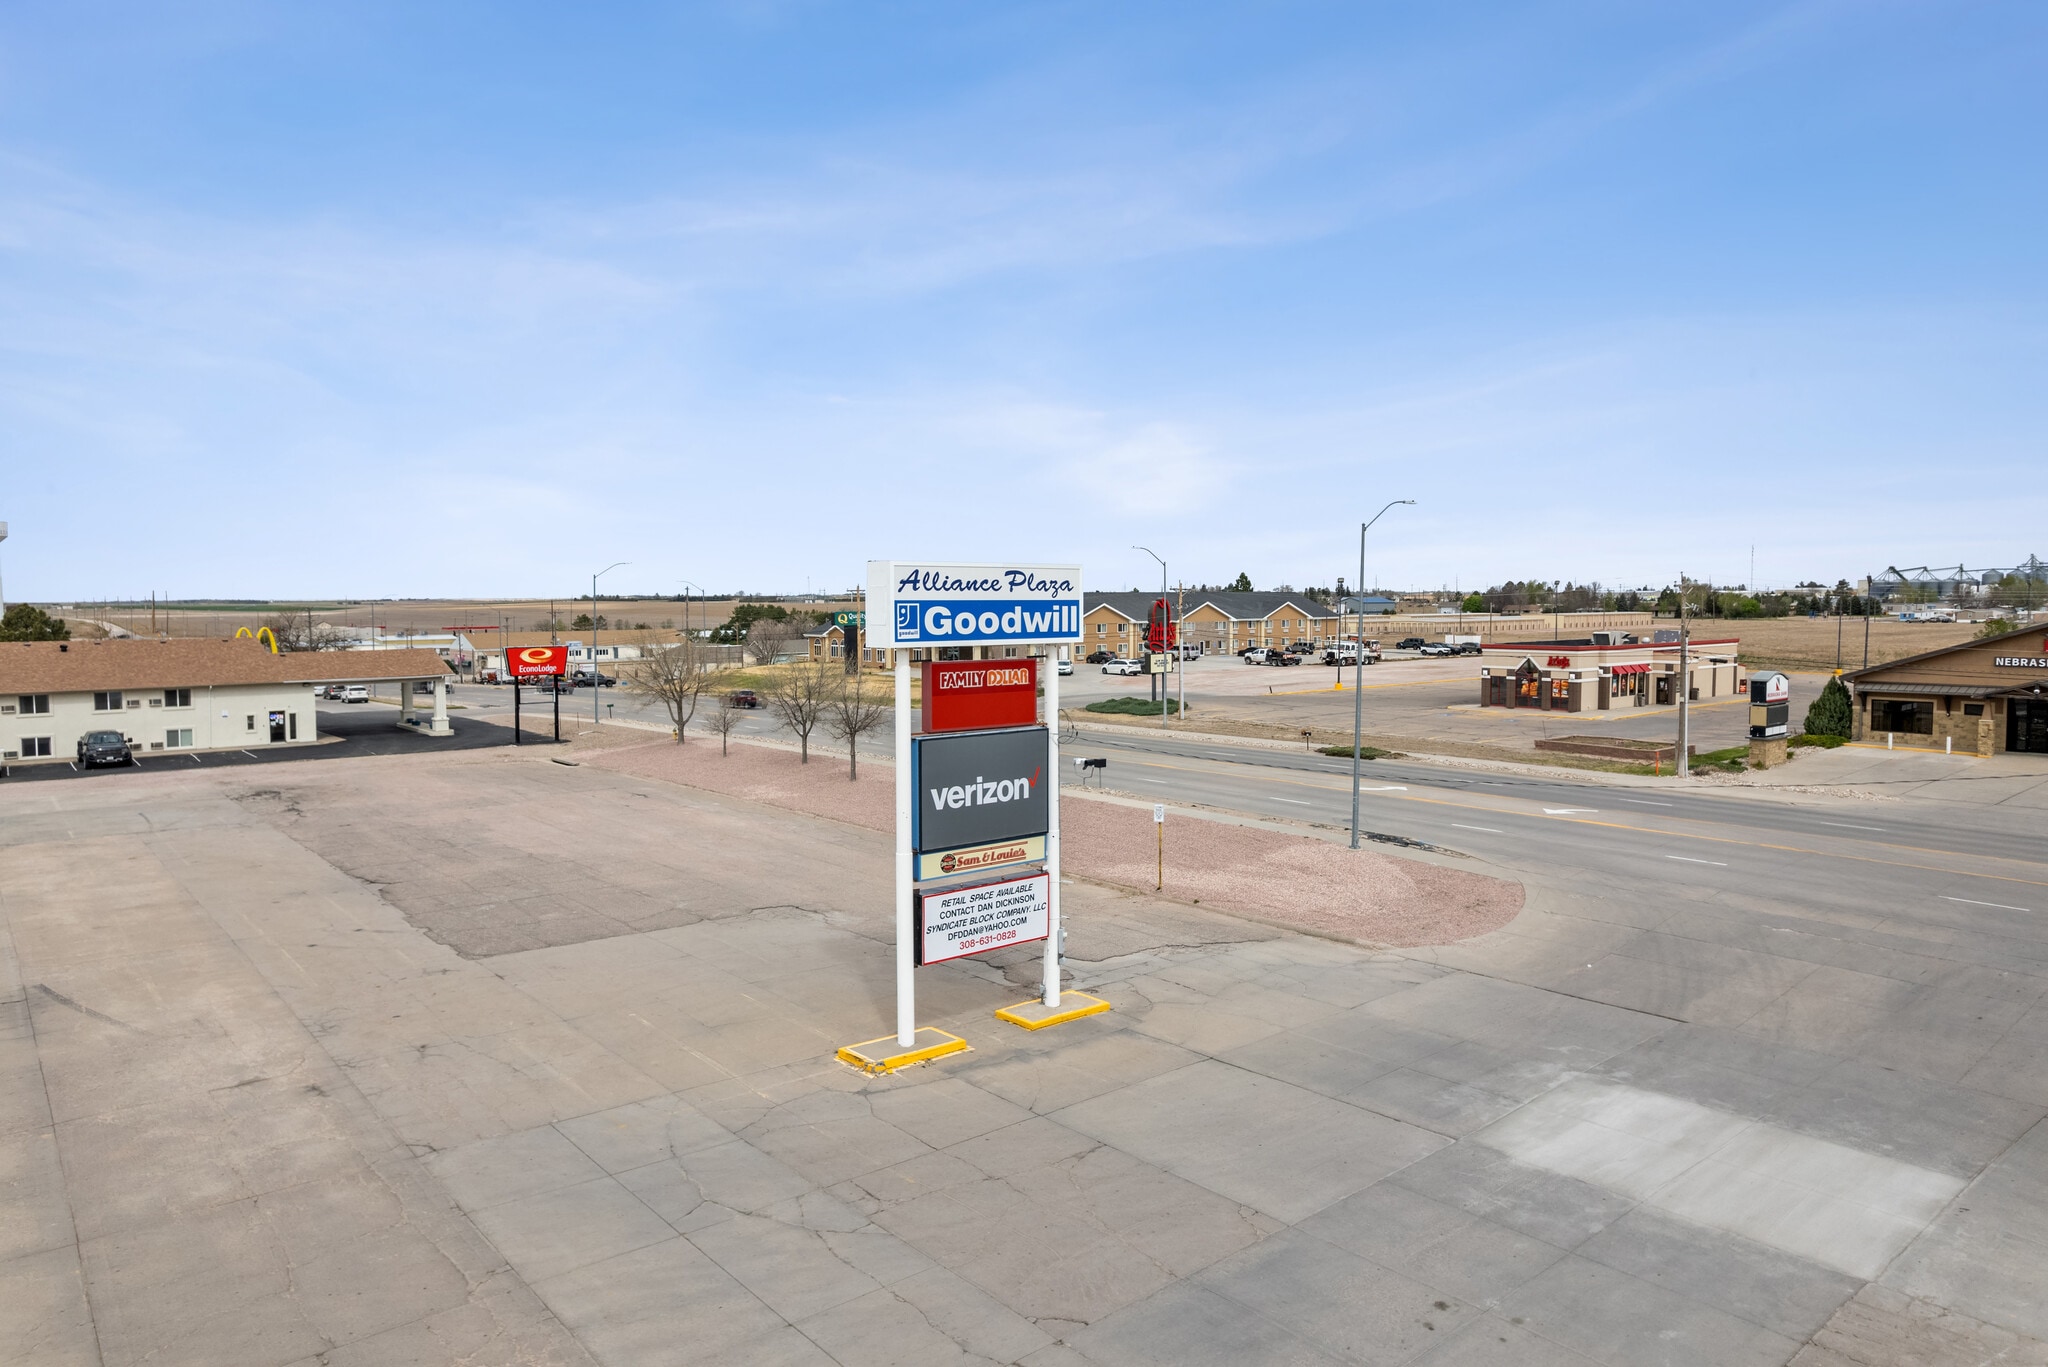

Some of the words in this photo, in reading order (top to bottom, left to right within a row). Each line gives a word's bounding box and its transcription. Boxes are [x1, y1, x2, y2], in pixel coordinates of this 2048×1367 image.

[898, 569, 1002, 593] Alliance
[1004, 570, 1074, 598] Plaza
[924, 605, 1078, 636] Goodwill
[940, 670, 985, 689] FAMILY
[987, 668, 1029, 686] DOLLAR
[930, 776, 1030, 811] verizon
[957, 856, 981, 867] Sam
[982, 852, 990, 862] &
[991, 848, 1026, 861] Louie's
[939, 905, 975, 920] CONTACT
[977, 902, 993, 912] DAN
[995, 893, 1035, 908] DICKINSON
[941, 896, 967, 908] RETAIL
[969, 890, 994, 903] SPACE
[995, 883, 1034, 898] AVAILABLE
[926, 918, 968, 935] SYNDICATE
[969, 912, 995, 926] BLOCK
[1033, 902, 1047, 912] LLC
[948, 916, 1028, 941] DFDDAN@YAHOO.COM
[959, 929, 1017, 950] 308-631-0828
